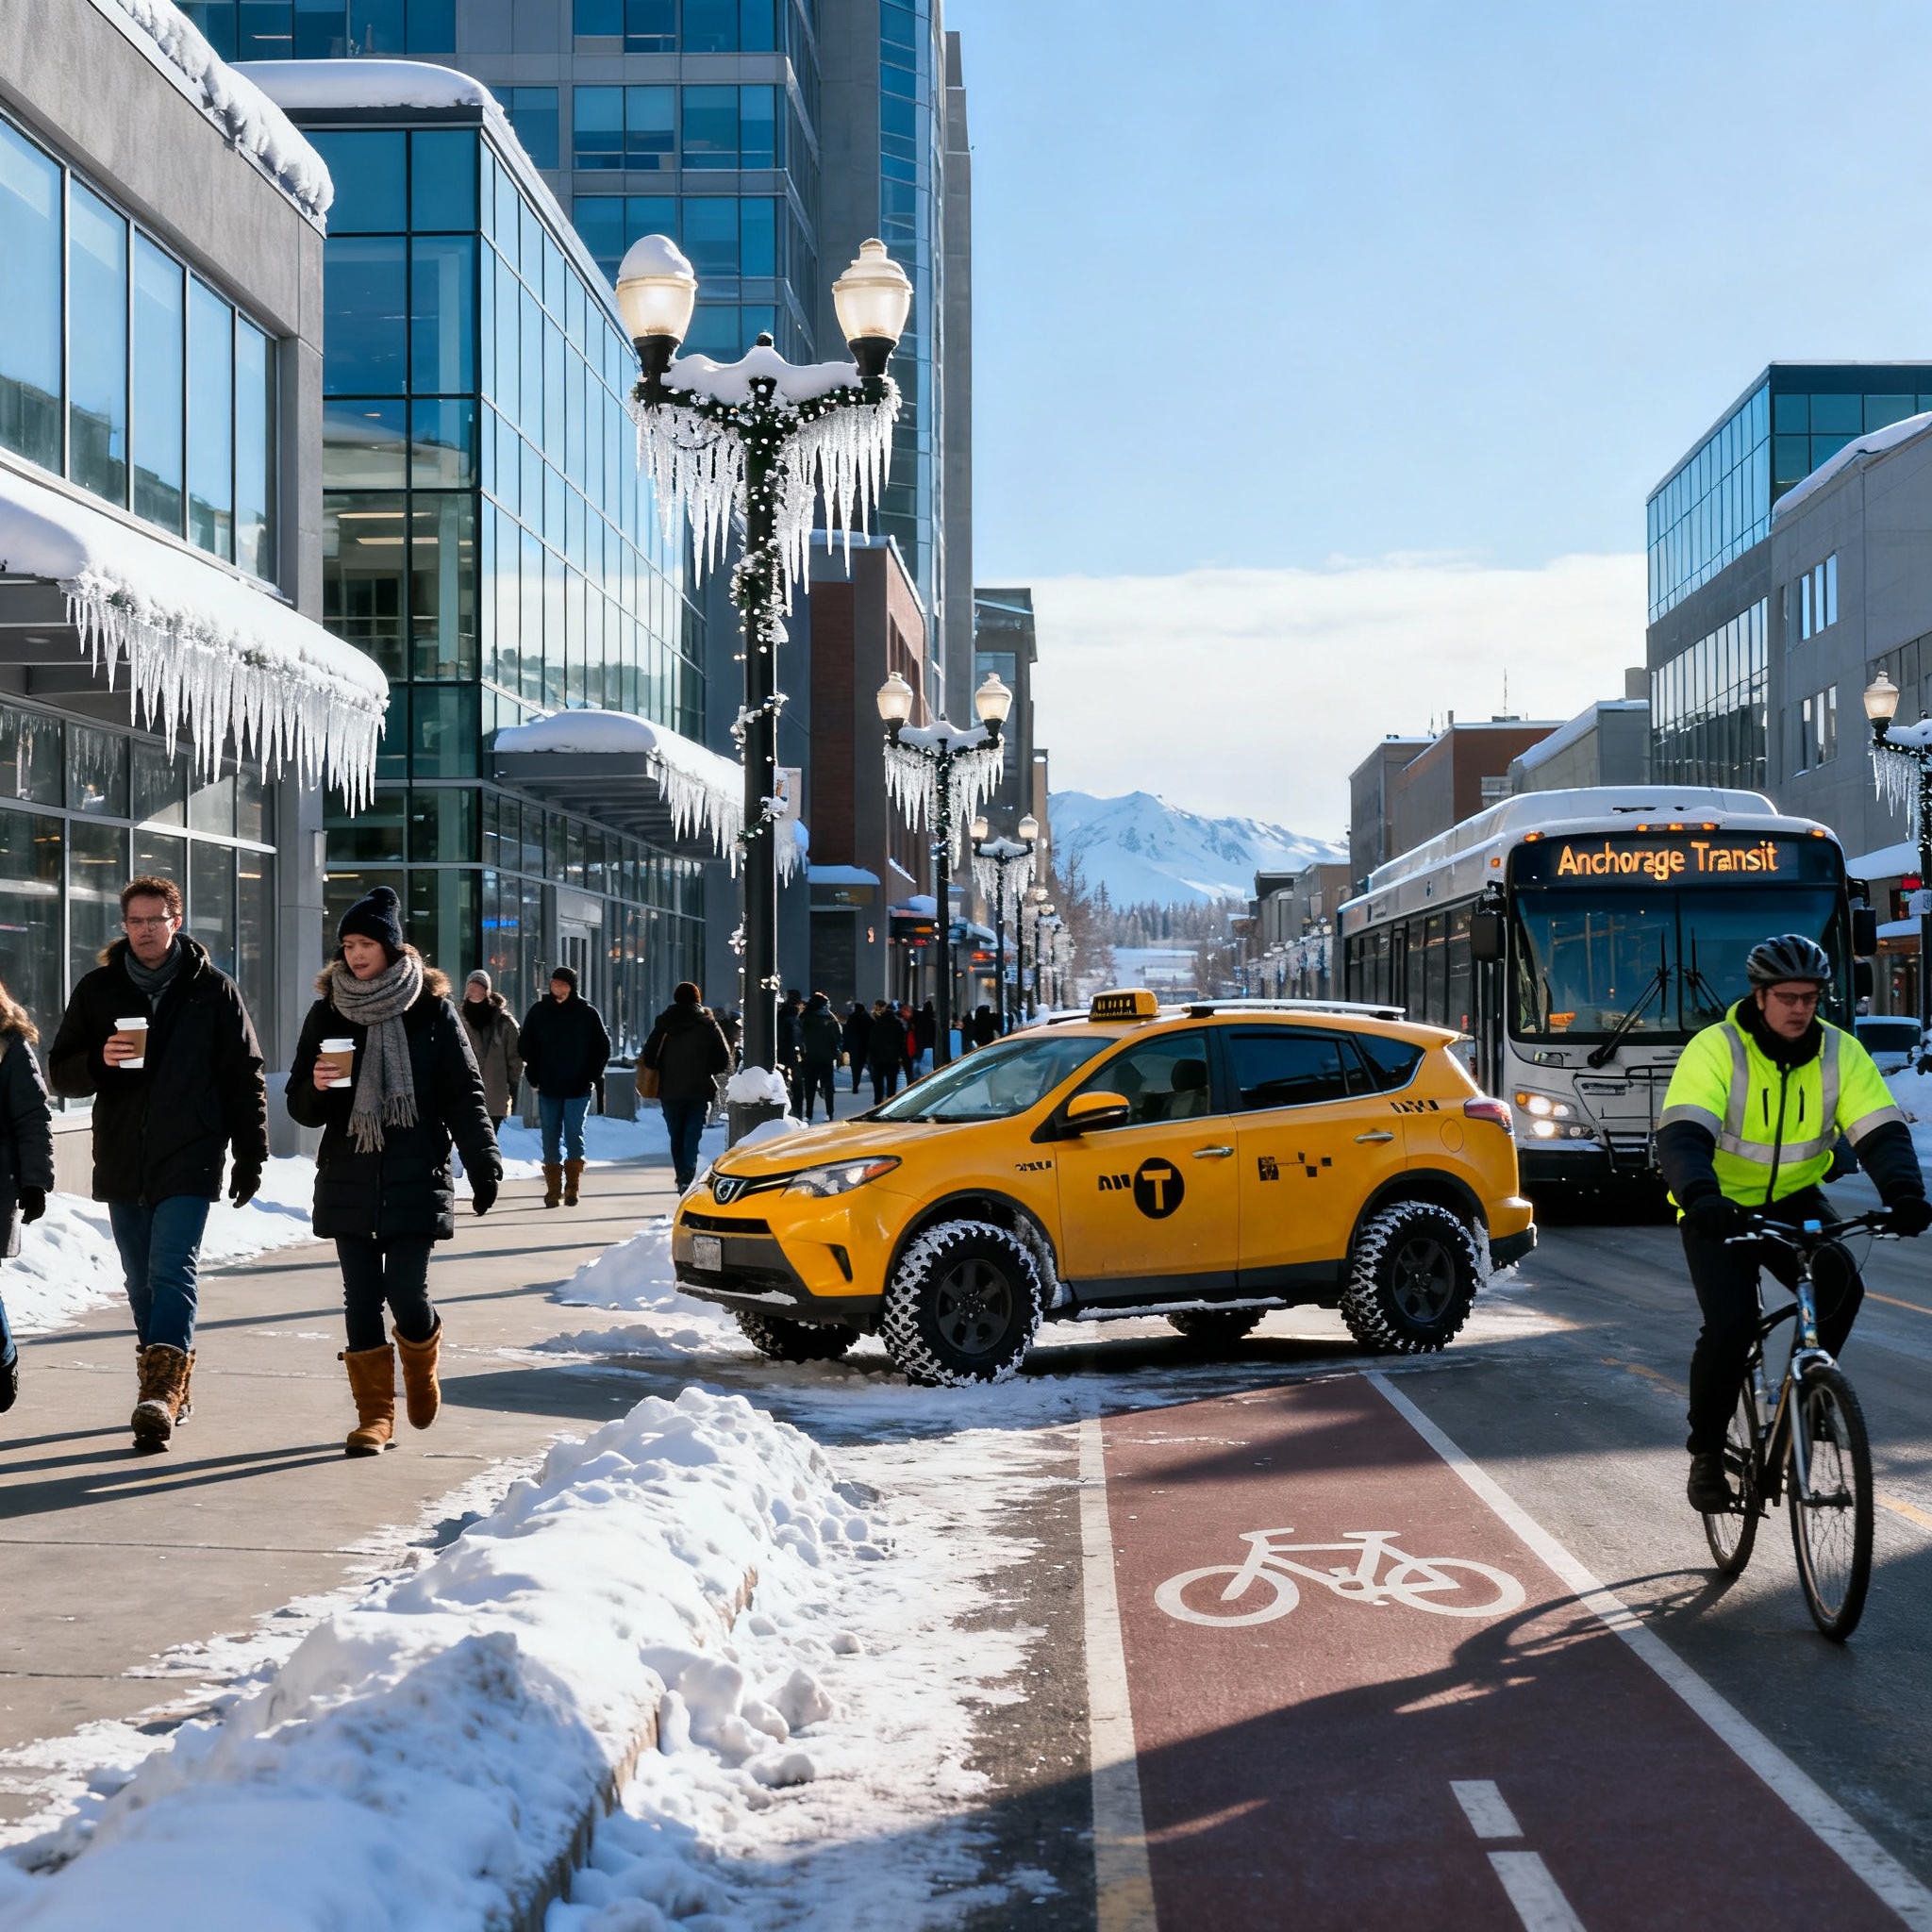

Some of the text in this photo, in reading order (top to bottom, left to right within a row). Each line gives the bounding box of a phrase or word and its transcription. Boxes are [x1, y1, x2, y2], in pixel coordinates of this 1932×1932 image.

[1557, 840, 1779, 881] Anchorage Transit
[1141, 1168, 1172, 1210] T
